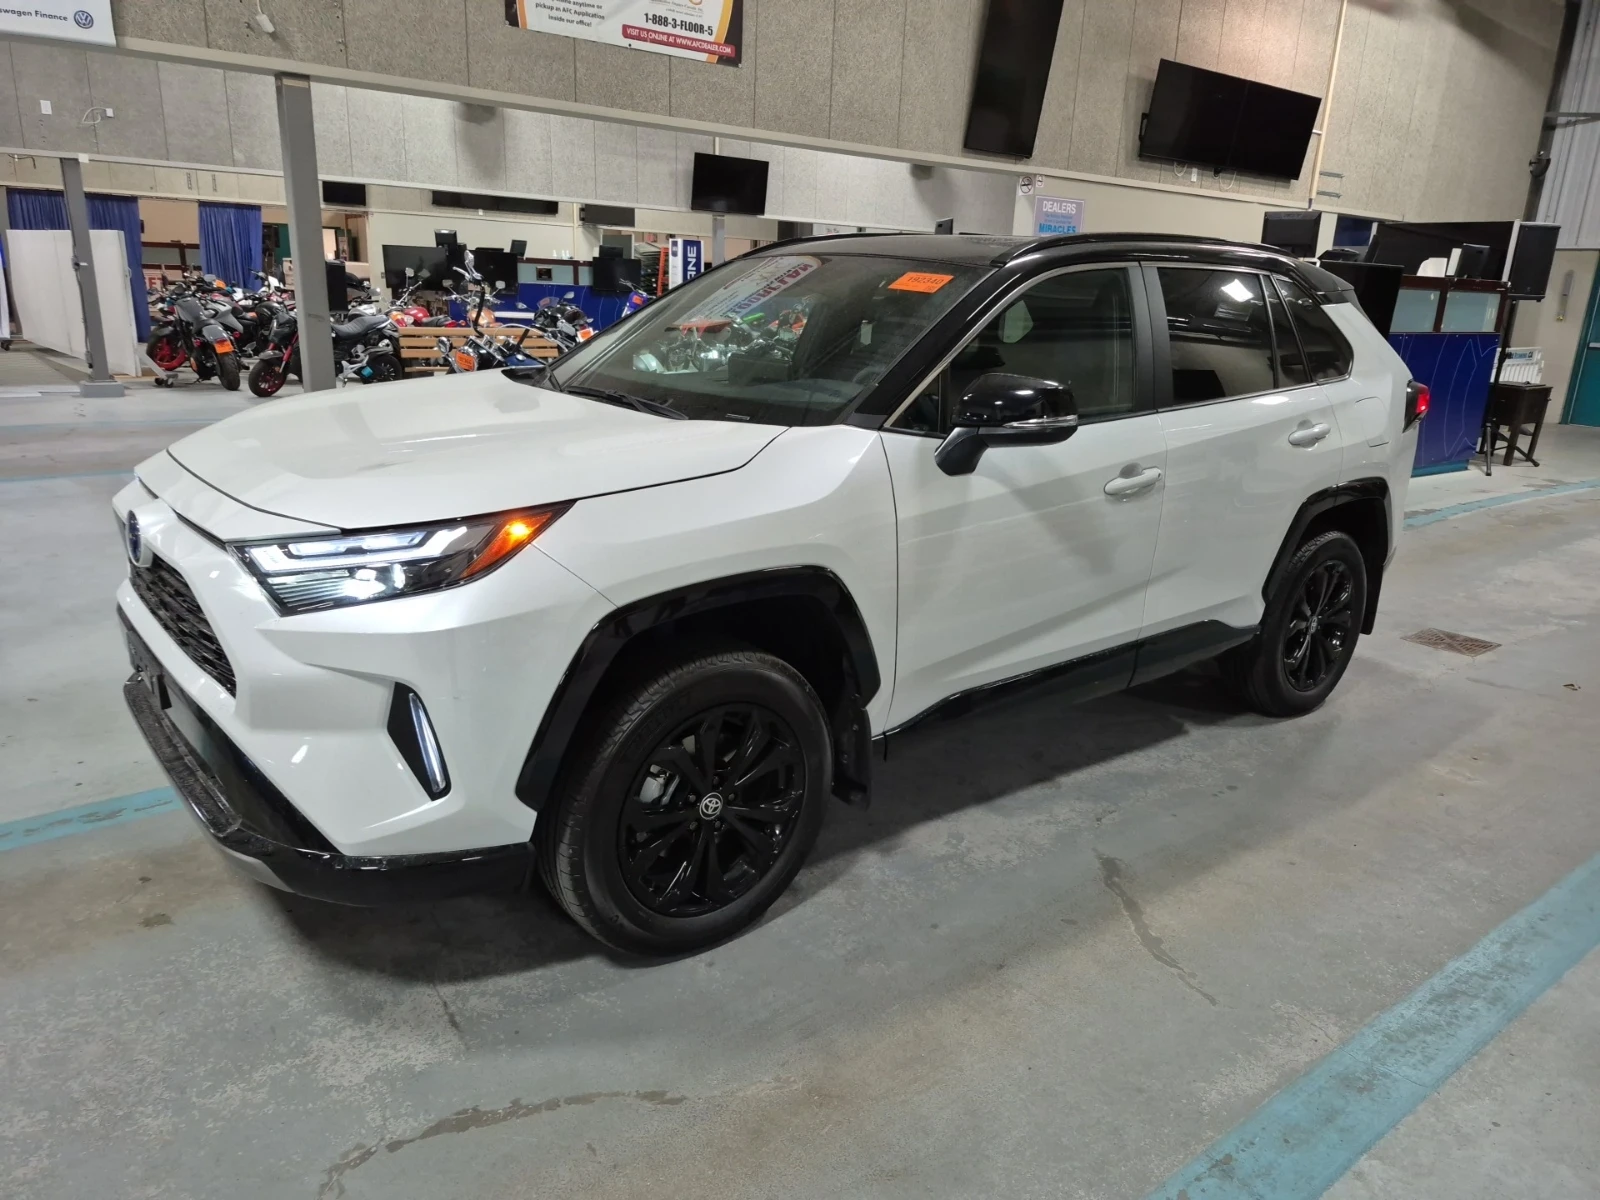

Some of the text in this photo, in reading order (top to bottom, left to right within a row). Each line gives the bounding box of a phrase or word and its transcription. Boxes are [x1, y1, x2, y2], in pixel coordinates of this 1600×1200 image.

[34, 10, 68, 21] Finance
[535, 2, 555, 11] pickup
[562, 7, 573, 15] AFC
[573, 9, 605, 20] Application
[575, 20, 592, 28] office!
[644, 12, 714, 36] 1-888-3-FLOOR-5
[626, 27, 640, 36] VISIT
[640, 30, 648, 38] US
[648, 32, 668, 42] ONLINE
[668, 35, 675, 43] AT
[1042, 200, 1077, 214] DEALERS
[1038, 222, 1077, 235] MIRACLES
